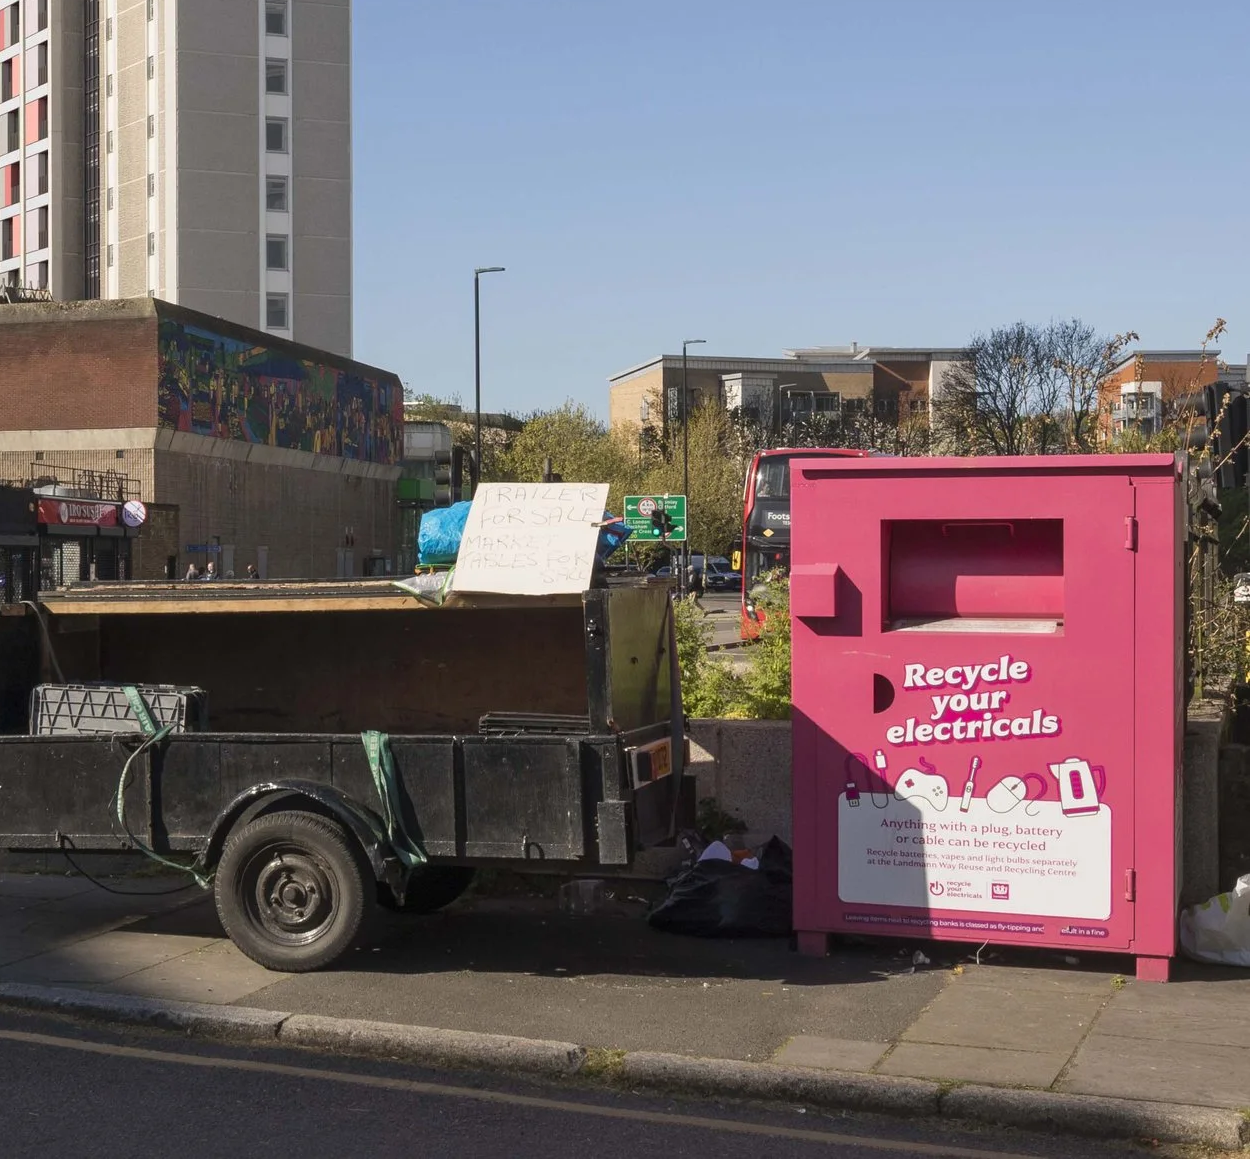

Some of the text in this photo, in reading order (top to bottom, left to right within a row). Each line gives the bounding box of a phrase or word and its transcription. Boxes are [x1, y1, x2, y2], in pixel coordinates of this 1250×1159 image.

[475, 486, 598, 506] TRAILER
[480, 506, 604, 529] FOR SALE
[546, 550, 589, 568] FOR
[903, 654, 1029, 690] Recycle
[930, 690, 1007, 720] your
[886, 708, 1059, 744] electricals
[880, 818, 936, 832] Anything
[940, 821, 967, 831] with
[982, 823, 1012, 836] plug,
[1016, 825, 1063, 839] battery
[912, 836, 944, 845] cable
[974, 838, 989, 848] be
[993, 841, 1046, 852] recycled
[867, 848, 1078, 867] Recycle batteries, vapes and light bulbs separately
[893, 859, 937, 868] Landmann
[939, 862, 956, 870] Way
[959, 863, 984, 871] Reuse
[1004, 866, 1046, 877] Recycling
[1048, 869, 1077, 877] Centre
[966, 921, 988, 929] classed
[998, 923, 1030, 932] fly-tipping
